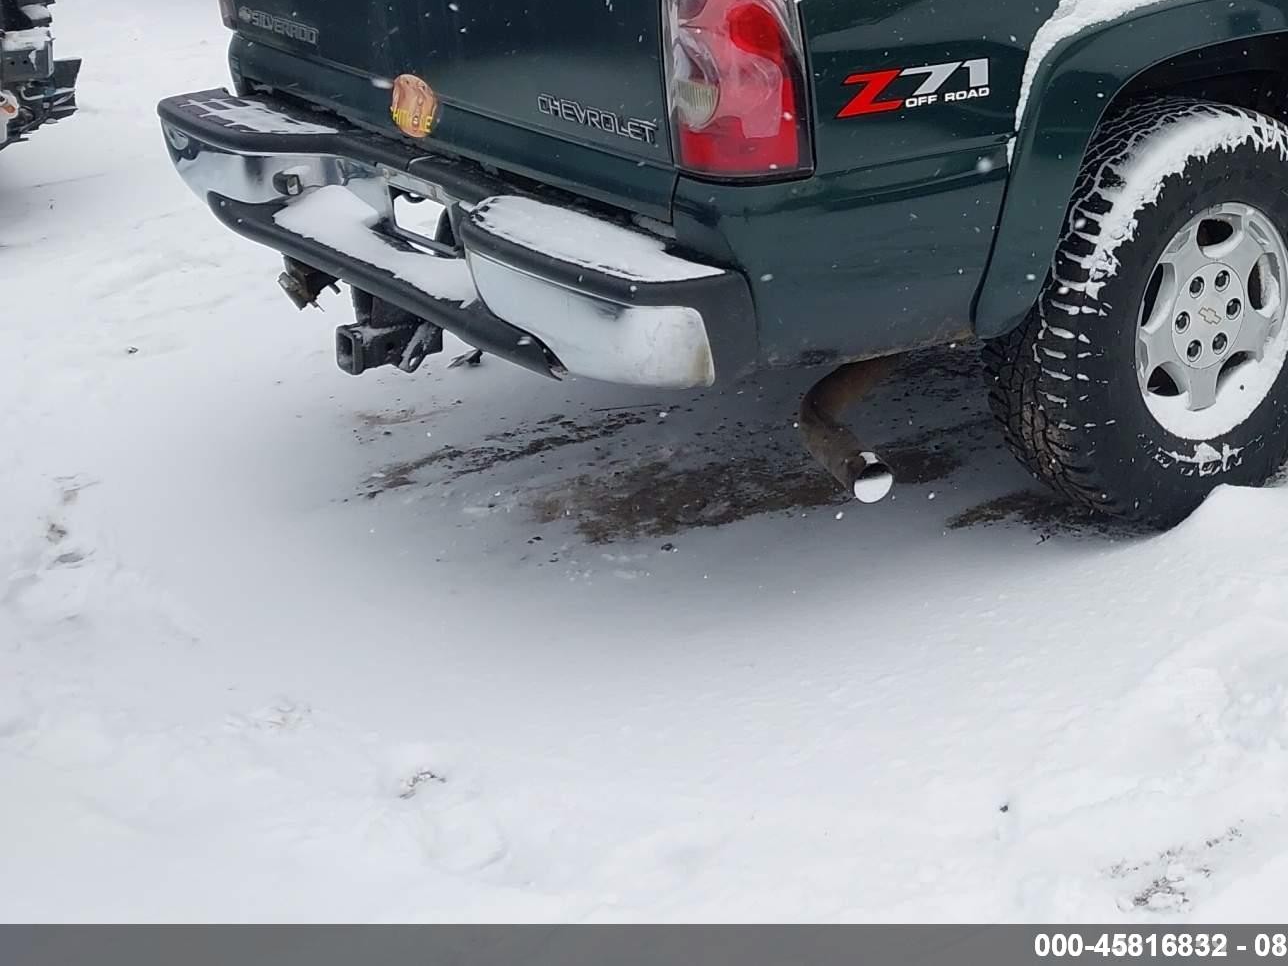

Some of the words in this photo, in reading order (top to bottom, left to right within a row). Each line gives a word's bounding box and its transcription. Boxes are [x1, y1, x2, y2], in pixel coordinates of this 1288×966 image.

[252, 10, 320, 45] SILVERADO
[833, 57, 990, 118] Z71
[905, 94, 938, 108] OFF
[944, 87, 990, 102] ROAD
[537, 93, 657, 144] CHEVROLET
